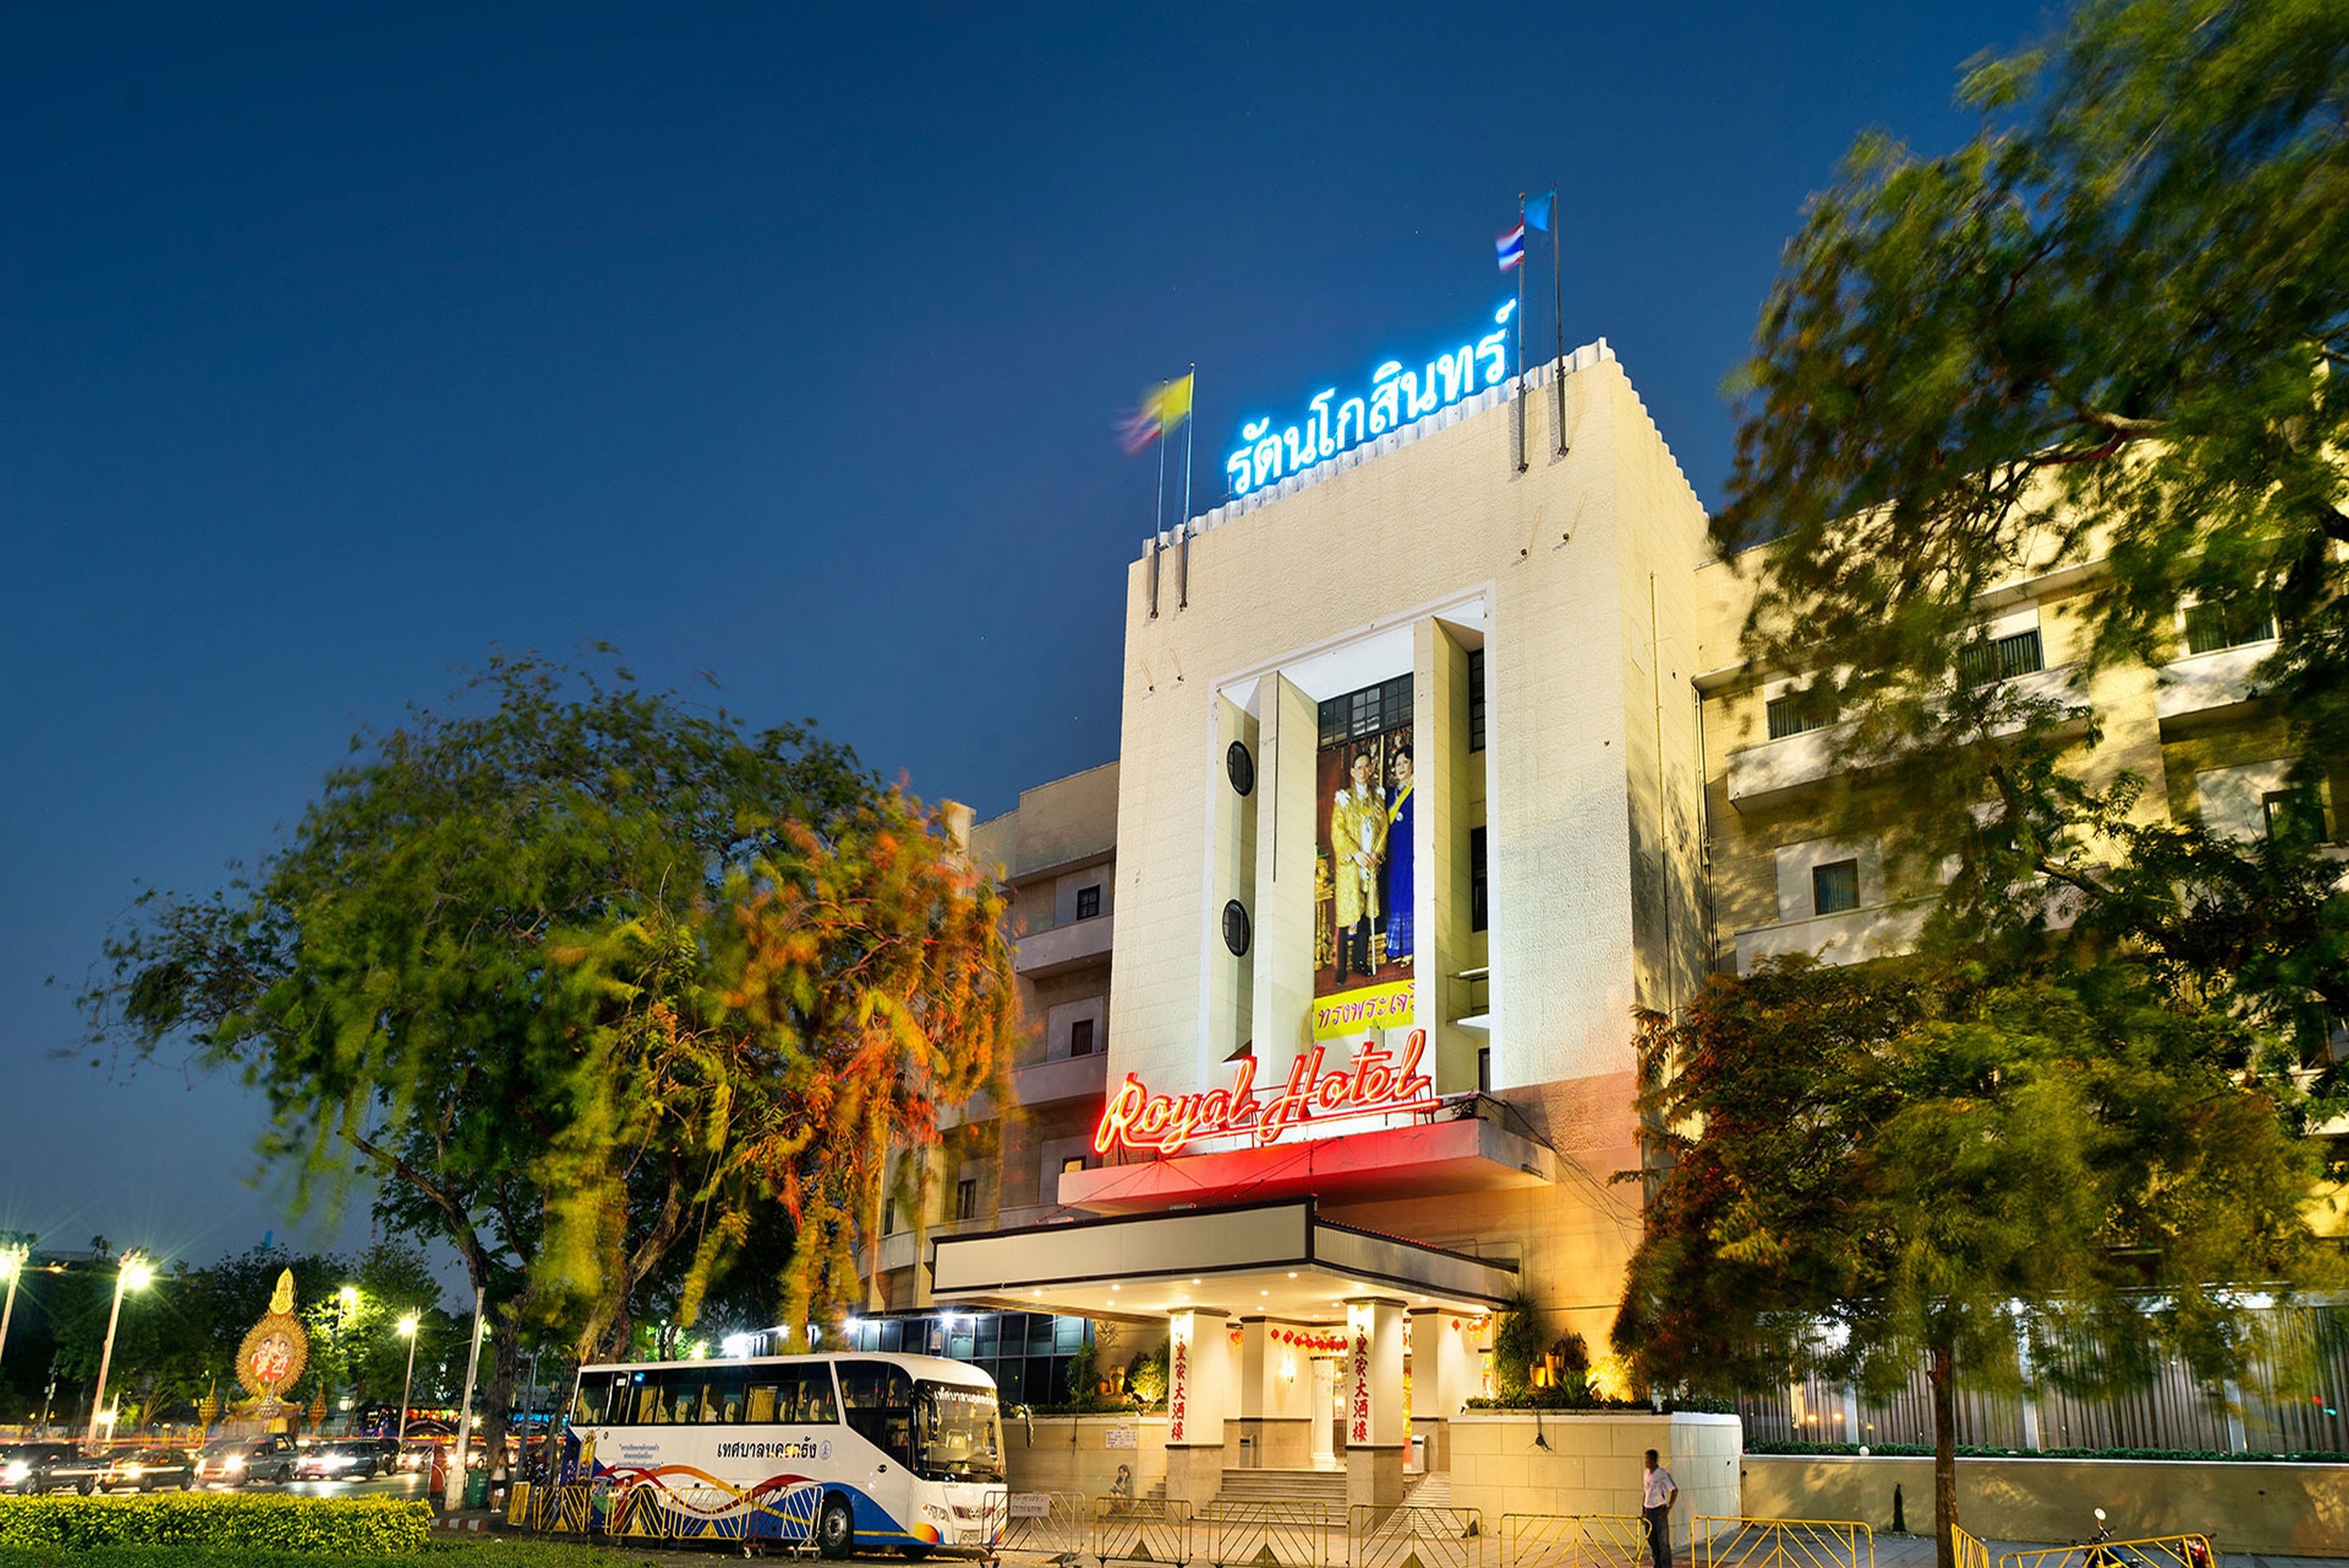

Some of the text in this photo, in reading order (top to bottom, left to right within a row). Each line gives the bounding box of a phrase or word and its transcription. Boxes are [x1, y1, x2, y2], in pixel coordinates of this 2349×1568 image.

[1227, 298, 1517, 494] รัตนโกสินทร์
[1093, 1028, 1431, 1154] Royal Hotel
